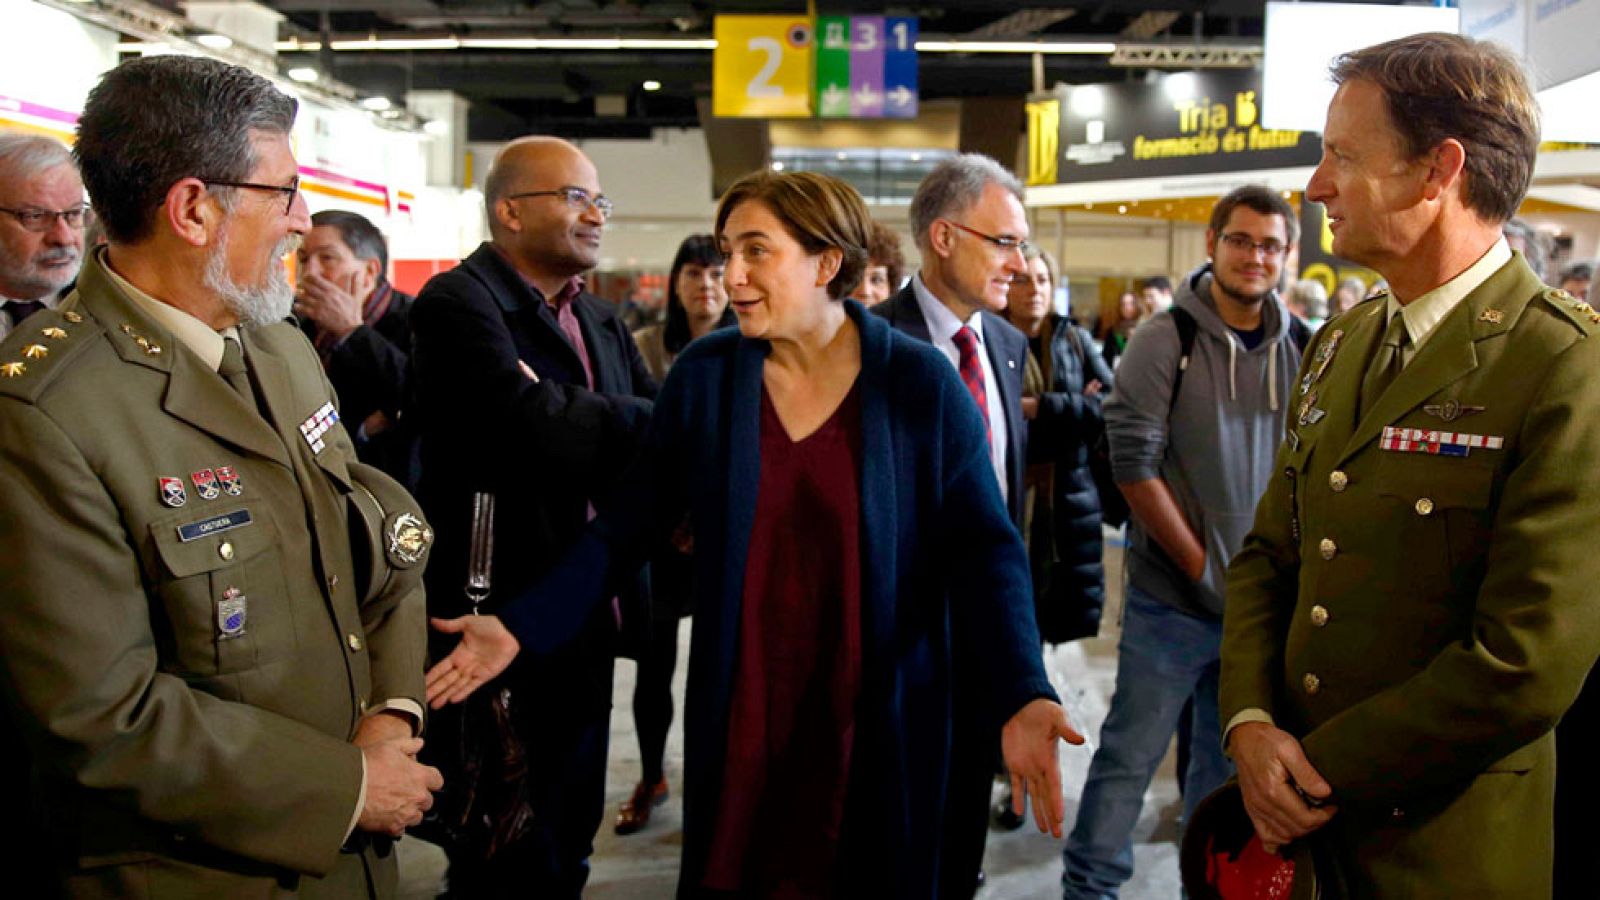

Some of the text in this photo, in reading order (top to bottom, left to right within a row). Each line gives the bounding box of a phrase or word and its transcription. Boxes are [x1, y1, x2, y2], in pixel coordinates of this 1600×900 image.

[857, 23, 907, 50] 3 1
[747, 37, 783, 98] 2
